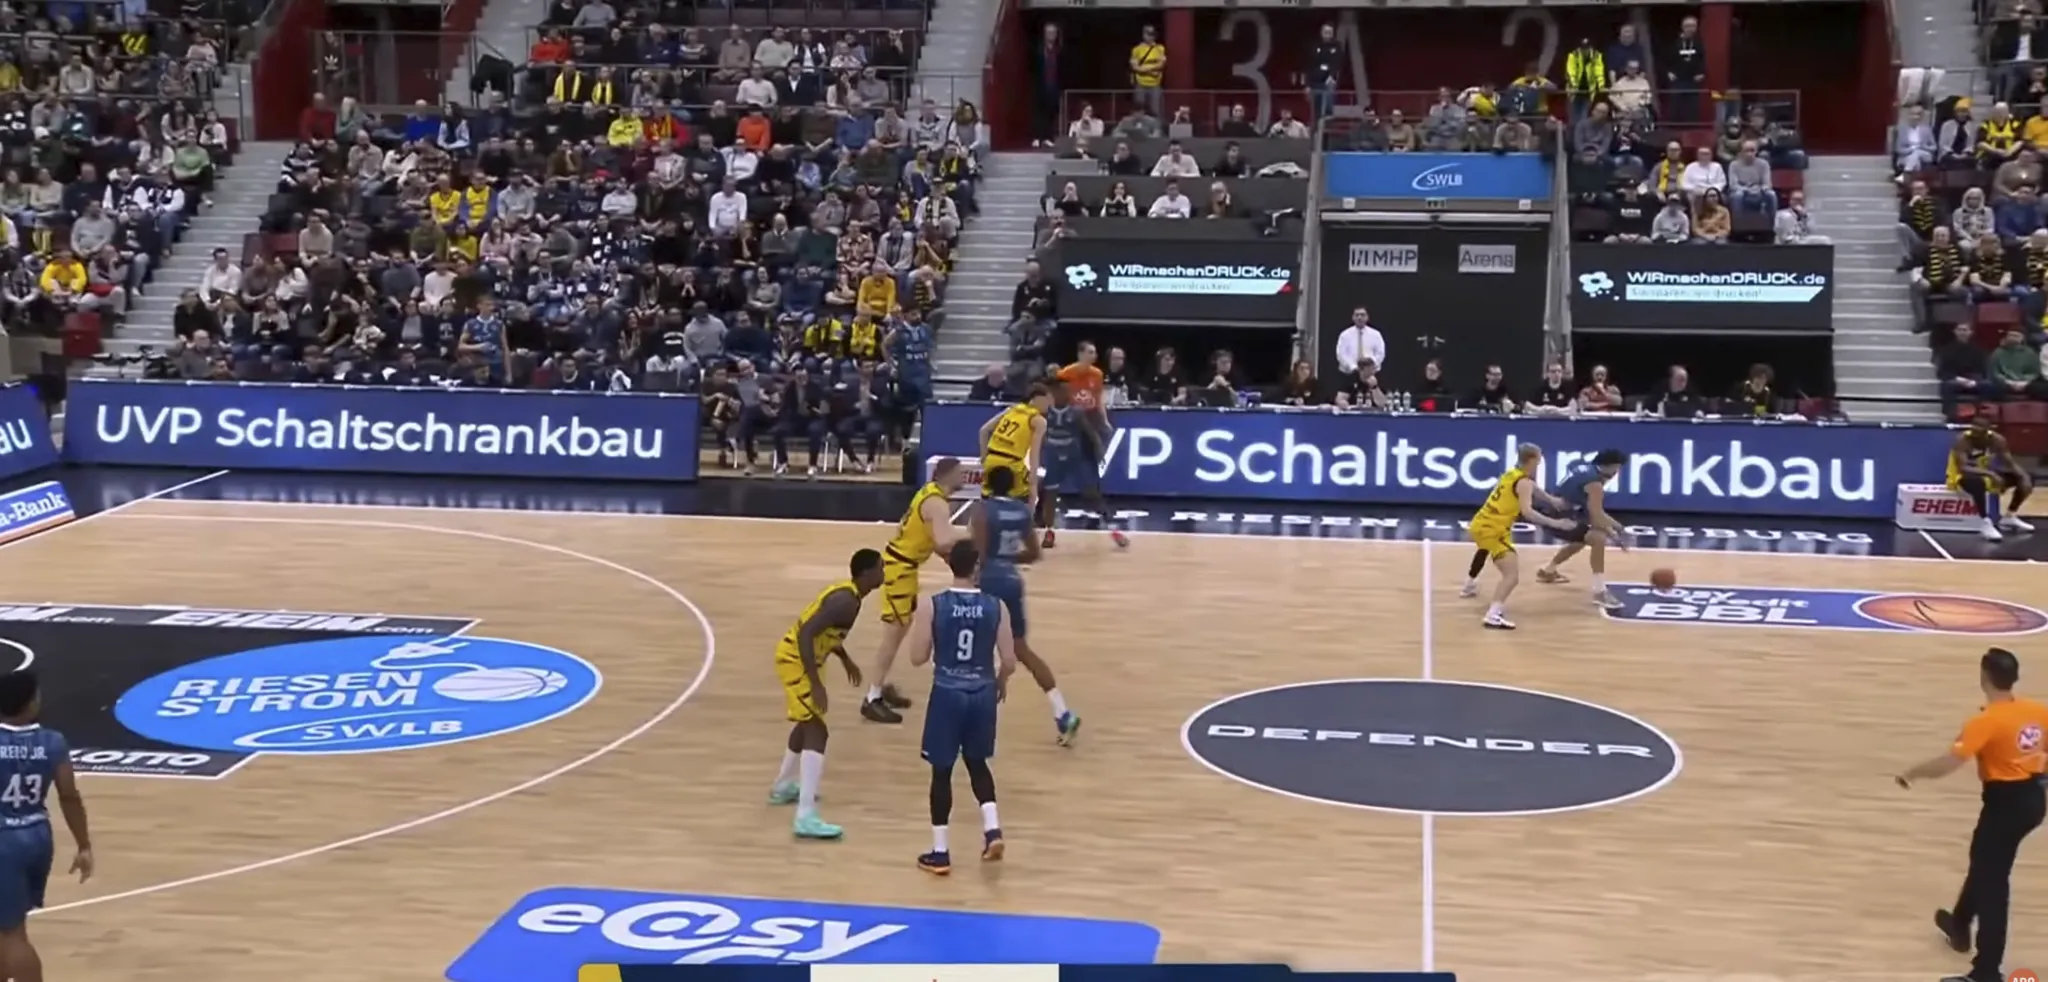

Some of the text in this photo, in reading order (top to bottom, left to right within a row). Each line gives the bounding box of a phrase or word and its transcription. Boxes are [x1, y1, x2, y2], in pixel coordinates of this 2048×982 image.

[1426, 173, 1463, 186] SWLB
[1459, 250, 1514, 268] Arena
[1109, 264, 1291, 279] WIRmachenDRUCK.de
[1627, 271, 1826, 286] WIRmachenDRUCK.de
[97, 405, 663, 458] UVP Schaltschrankbau
[997, 418, 1020, 437] 37
[952, 604, 984, 618] ZIPSER
[1636, 603, 1818, 624] BBL
[956, 628, 974, 661] 9
[171, 671, 422, 698] RIESEN
[156, 689, 418, 717] STROM
[301, 720, 463, 741] SWLB
[1207, 724, 1655, 758] DEFENDER
[2, 772, 42, 809] 43
